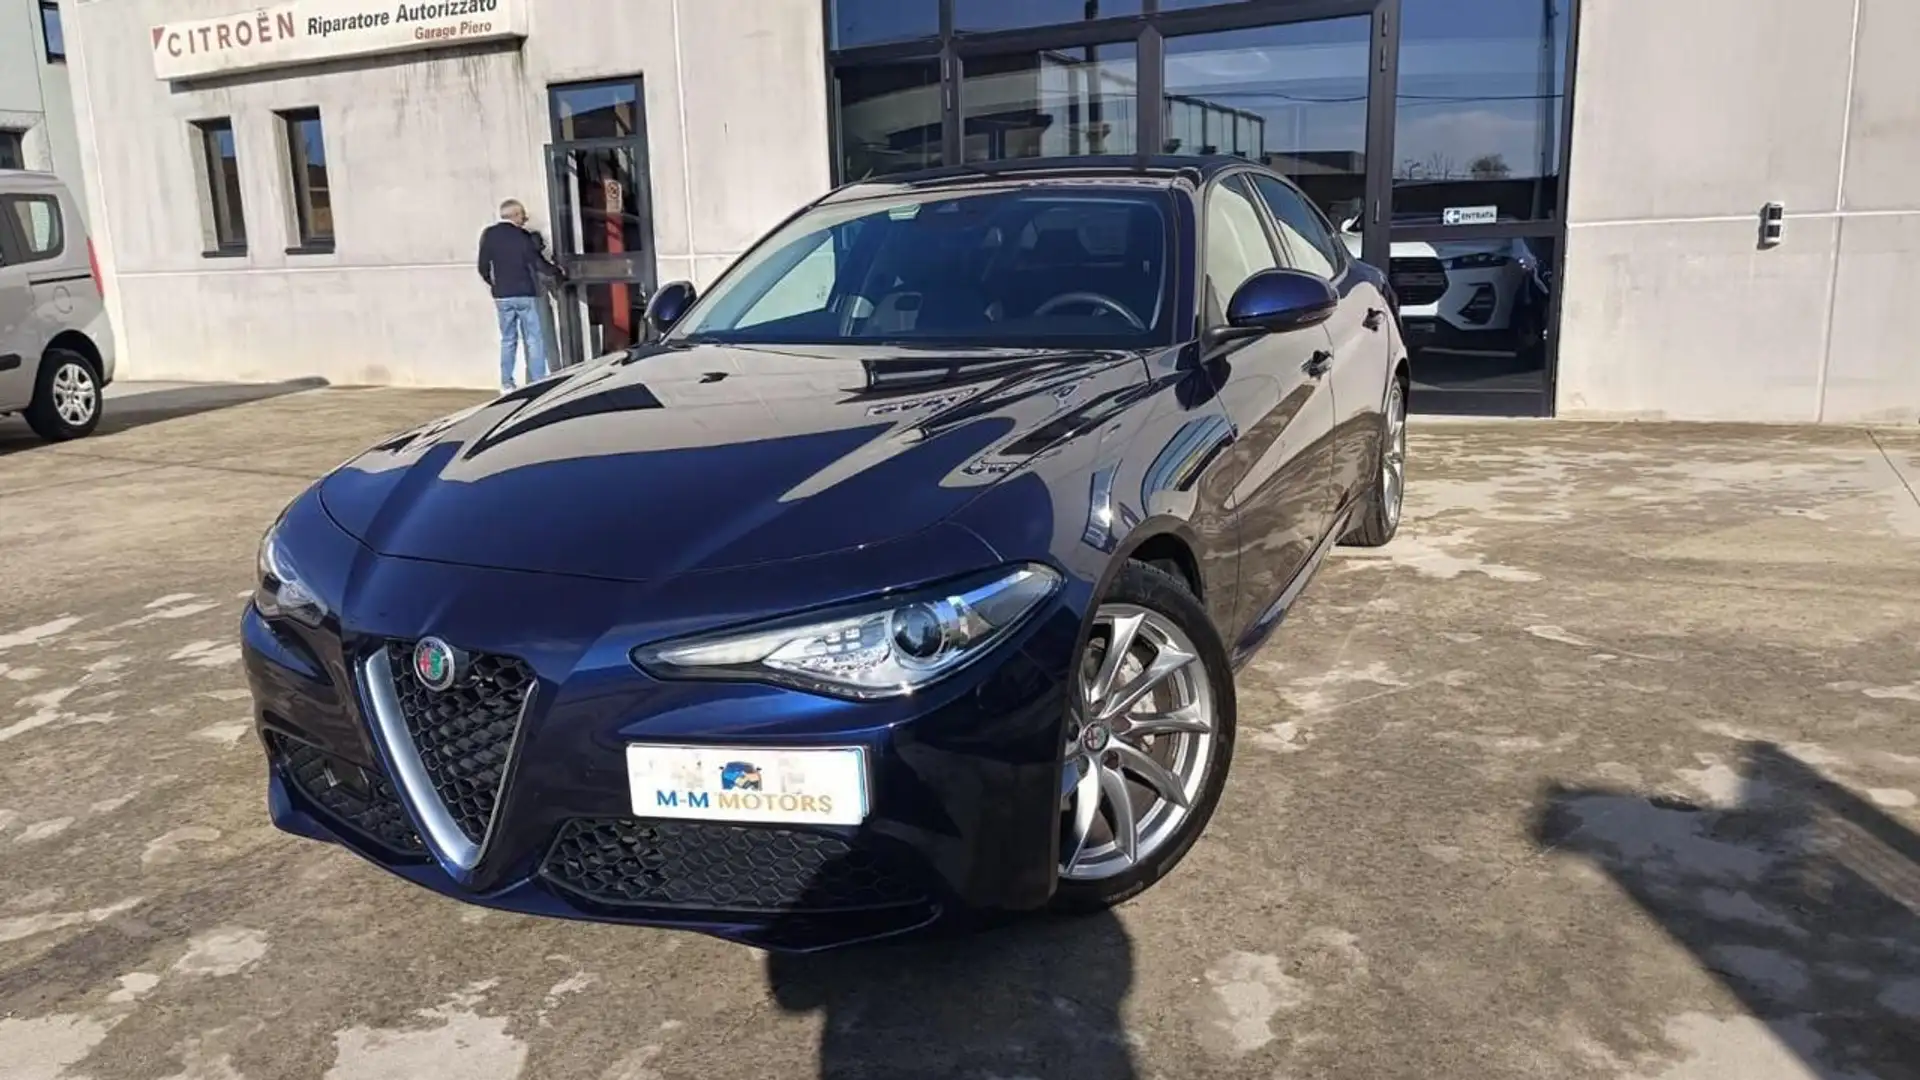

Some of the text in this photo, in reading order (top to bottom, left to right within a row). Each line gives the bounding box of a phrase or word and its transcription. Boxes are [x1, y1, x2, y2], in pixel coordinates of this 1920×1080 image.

[168, 0, 497, 57] CITROËN Riparatore Autorizzato
[415, 21, 492, 40] Garage Piero
[1461, 211, 1494, 220] ENTRATA
[656, 790, 832, 814] M-M MOTORS
